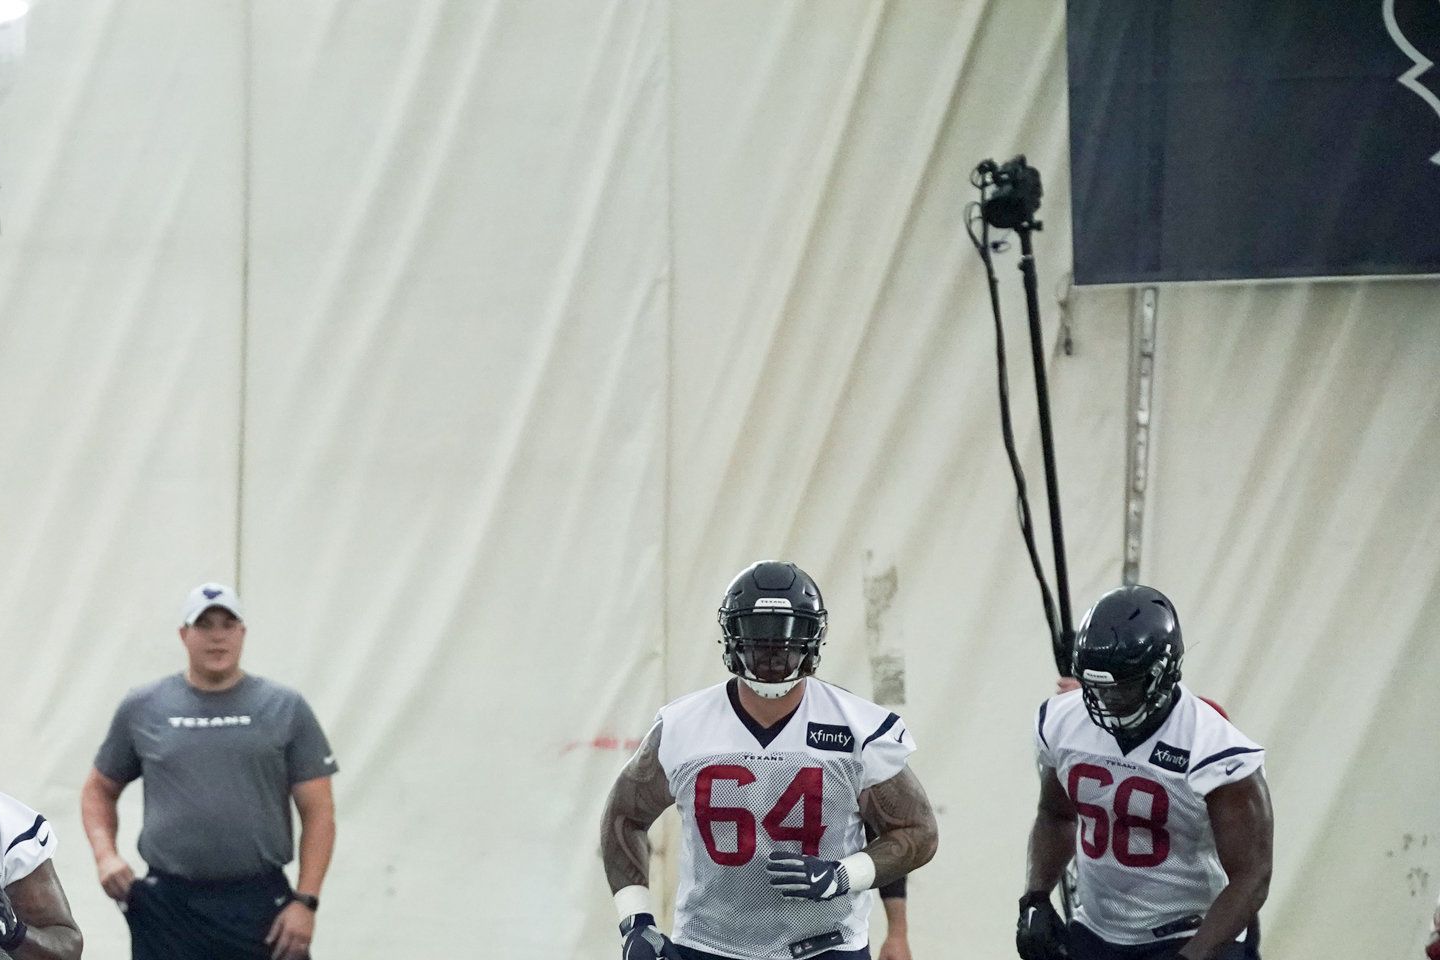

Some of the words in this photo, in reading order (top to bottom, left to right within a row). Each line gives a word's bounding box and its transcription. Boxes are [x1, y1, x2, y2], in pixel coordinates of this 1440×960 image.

[168, 715, 251, 728] TEXANS
[810, 729, 852, 746] xfinity
[1155, 749, 1189, 769] xfinity
[694, 764, 828, 867] 64
[1068, 763, 1170, 867] 68
